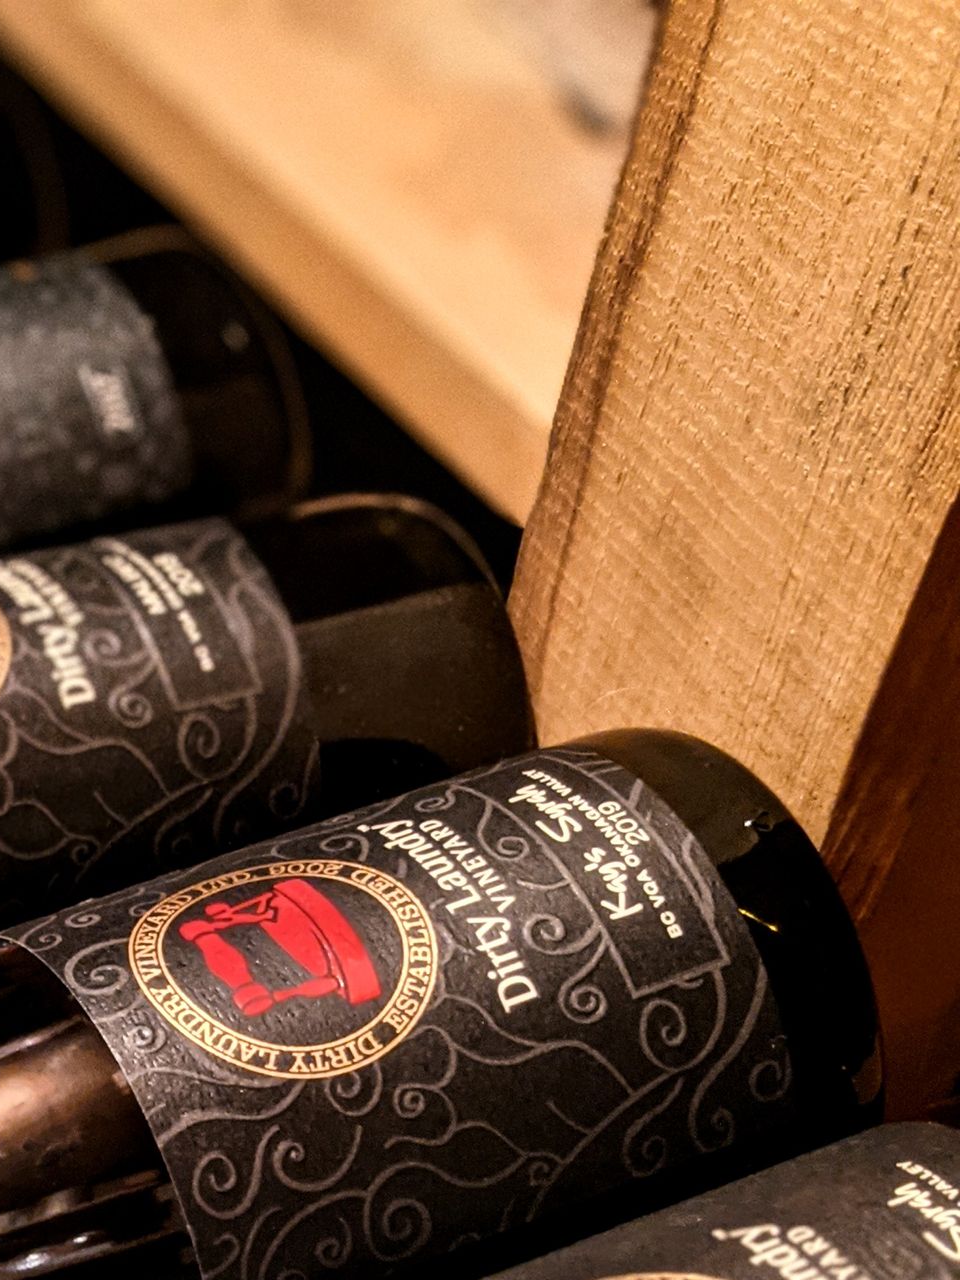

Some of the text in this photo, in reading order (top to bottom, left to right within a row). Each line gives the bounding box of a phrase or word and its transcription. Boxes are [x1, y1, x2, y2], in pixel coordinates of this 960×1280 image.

[37, 624, 96, 710] Dirty
[419, 818, 517, 913] VINEYARD
[508, 784, 644, 921] Kay's Syrah
[521, 768, 683, 940] BC VQA OKANAGAN VALLEY
[597, 801, 651, 847] 2019
[136, 892, 195, 982] VINEYARD
[350, 865, 432, 1034] ESTABLISHED
[369, 818, 539, 1014] Dirty Laundry
[152, 984, 281, 1070] LAUNDRY
[289, 1029, 384, 1073] DIRTY
[886, 1182, 960, 1261] Syrah
[895, 1161, 959, 1201] VALLEY
